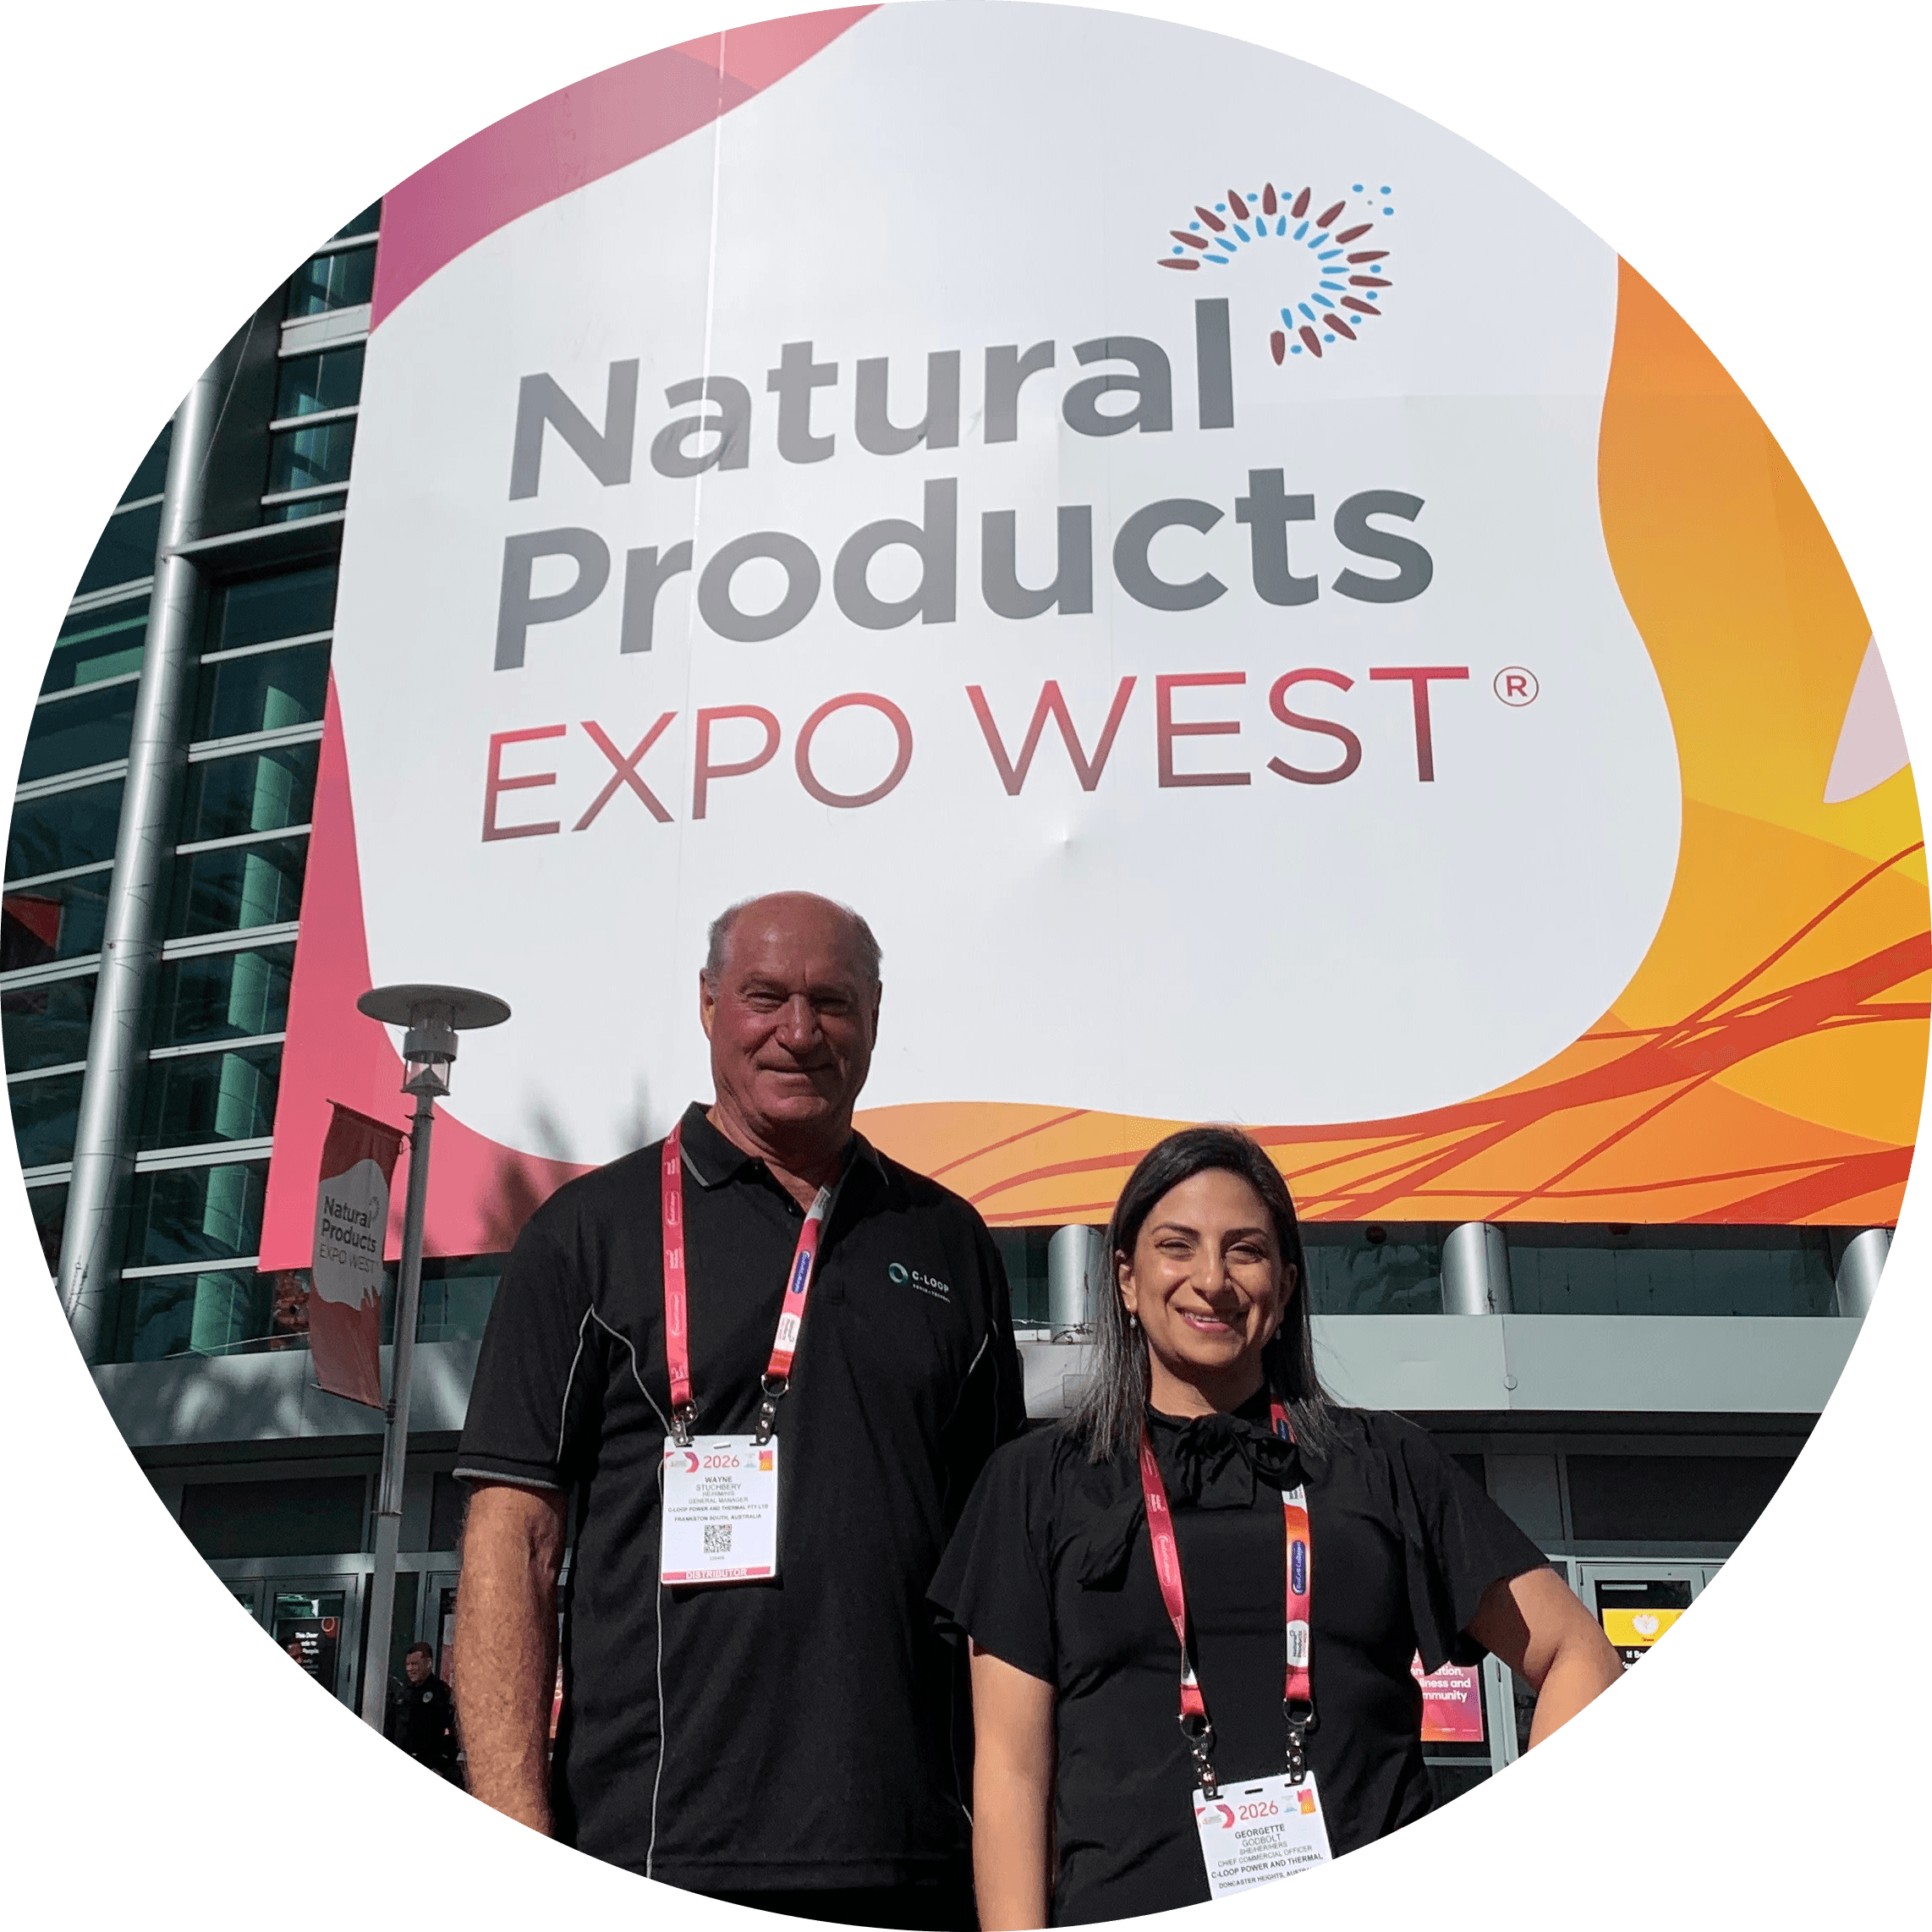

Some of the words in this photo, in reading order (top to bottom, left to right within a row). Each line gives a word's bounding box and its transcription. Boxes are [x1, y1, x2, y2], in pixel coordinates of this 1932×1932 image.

[508, 298, 1235, 502] Natural
[493, 468, 1434, 672] Products
[481, 692, 914, 843] EXPO
[324, 1195, 371, 1229] Natural
[321, 1218, 377, 1253] Products
[320, 1243, 347, 1265] EXPO
[703, 1454, 740, 1468] 2026
[695, 1483, 741, 1491] STUCHBERY
[686, 1568, 747, 1579] DISTRIBUTOR
[1450, 1677, 1472, 1688] and
[1422, 1690, 1468, 1703] mmunity
[1238, 1800, 1279, 1820] 2026
[1234, 1824, 1285, 1839] GEORGETTE
[1242, 1834, 1281, 1847] GODBOLT
[1210, 1867, 1239, 1879] C-LOOP
[1241, 1863, 1269, 1873] POWER
[1270, 1859, 1287, 1869] AND
[1287, 1853, 1324, 1865] THERMAL
[1217, 1859, 1238, 1868] CHIEF
[1238, 1852, 1282, 1865] COMMERCIAL
[1284, 1845, 1313, 1856] OFFICER
[1219, 1877, 1256, 1889] DONCASTER
